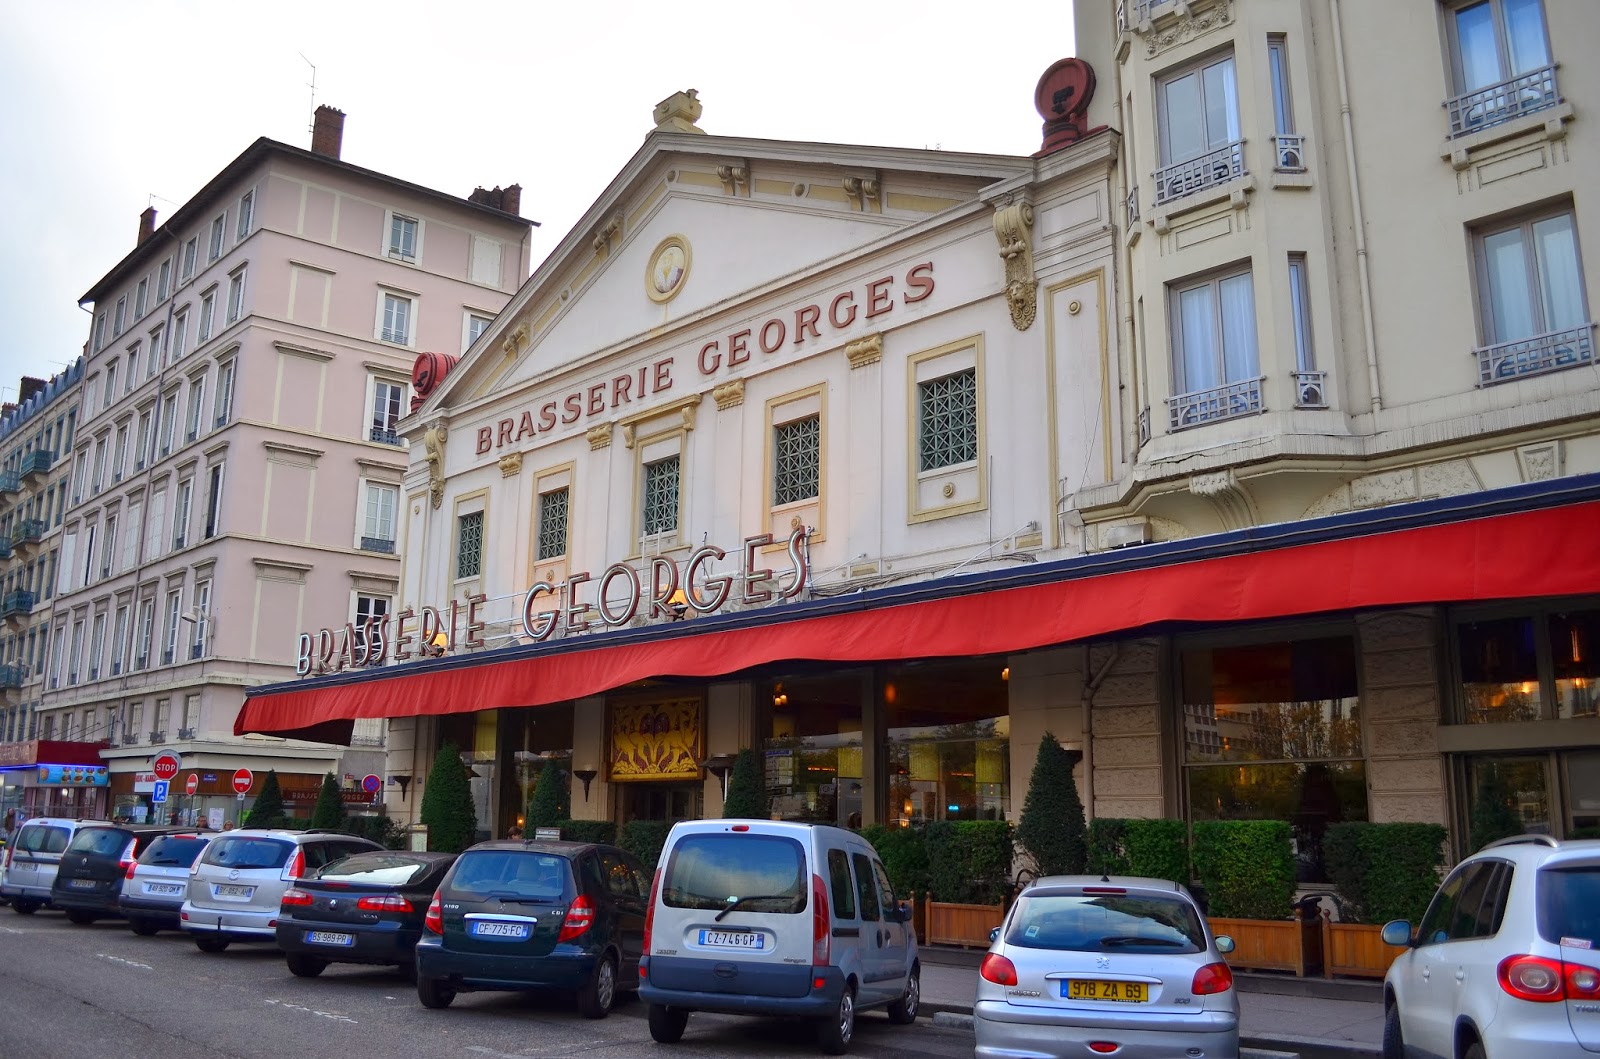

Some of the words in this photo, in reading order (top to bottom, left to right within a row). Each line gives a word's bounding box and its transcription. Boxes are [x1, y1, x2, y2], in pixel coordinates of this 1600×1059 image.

[475, 357, 674, 455] BRASSERIE
[697, 261, 936, 376] GEORGES
[296, 593, 487, 677] BRASSERIE
[521, 525, 807, 641] GEORGES
[156, 763, 176, 772] STOP
[157, 784, 164, 798] P
[292, 792, 319, 800] BRASSE
[341, 793, 365, 801] ORGES
[478, 923, 522, 936] CF-775-FC
[312, 932, 347, 943] BS-989-PR
[707, 932, 755, 946] CZ-746-GP
[1073, 981, 1096, 996] 978
[1102, 982, 1119, 998] ZA
[1125, 984, 1142, 999] 69
